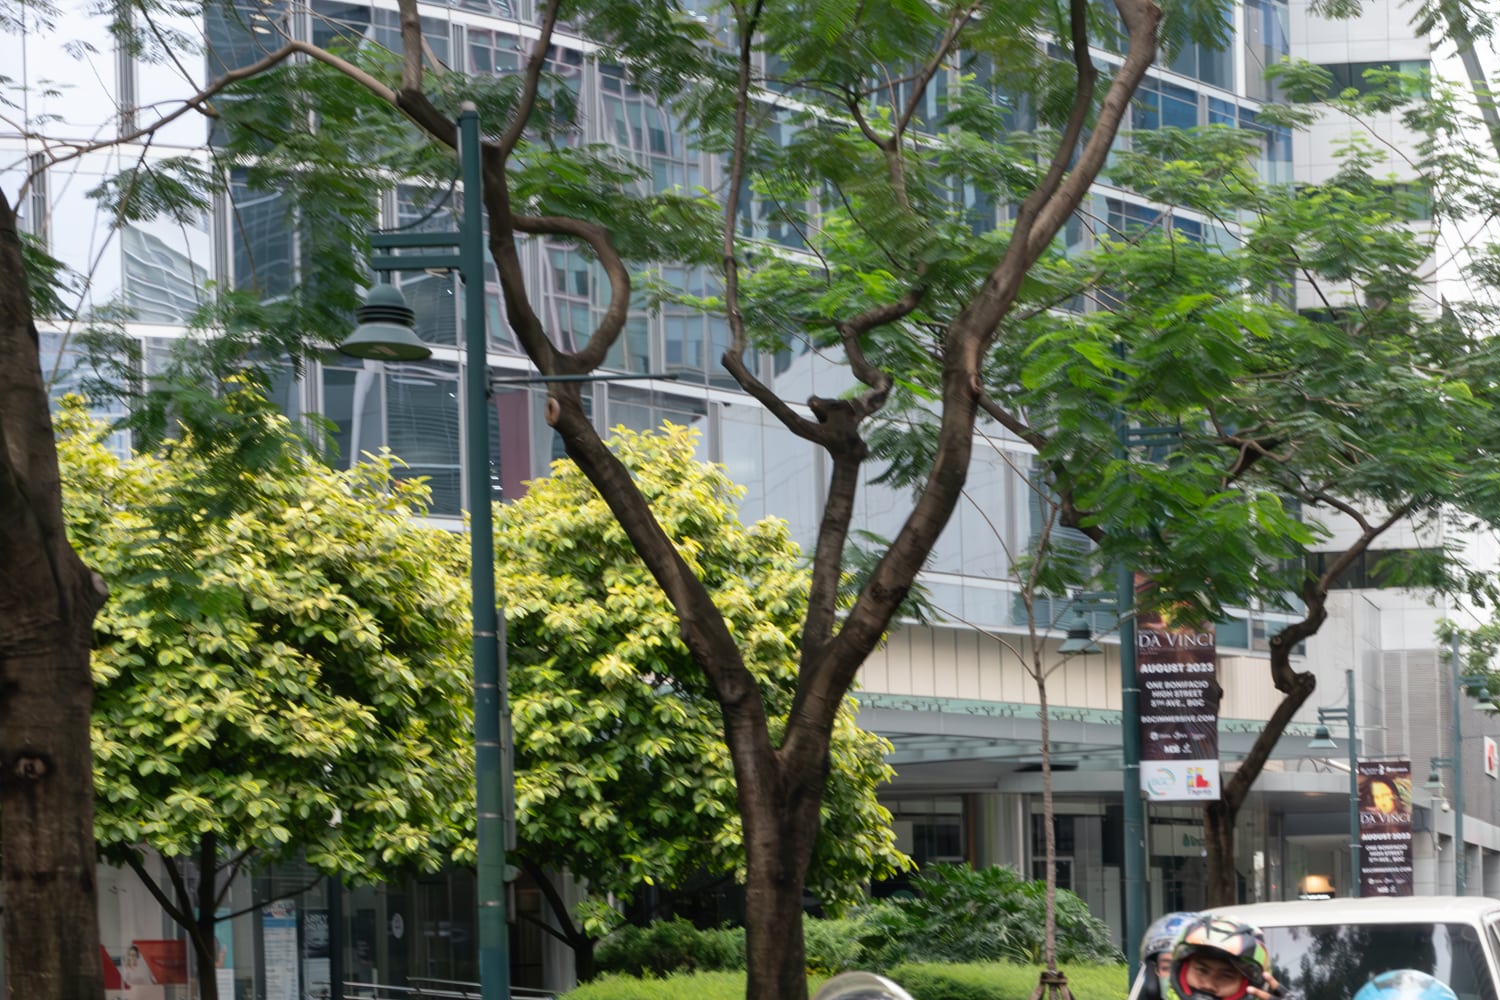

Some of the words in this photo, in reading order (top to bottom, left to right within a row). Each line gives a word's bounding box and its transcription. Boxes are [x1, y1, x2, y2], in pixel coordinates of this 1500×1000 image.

[1138, 633, 1162, 648] DA
[1165, 631, 1214, 647] VINCI
[1140, 663, 1185, 674] AUGUST
[1186, 662, 1215, 673] 2023
[1360, 813, 1376, 823] DA
[1379, 812, 1411, 823] VINCI
[1361, 833, 1391, 841] AUGUST
